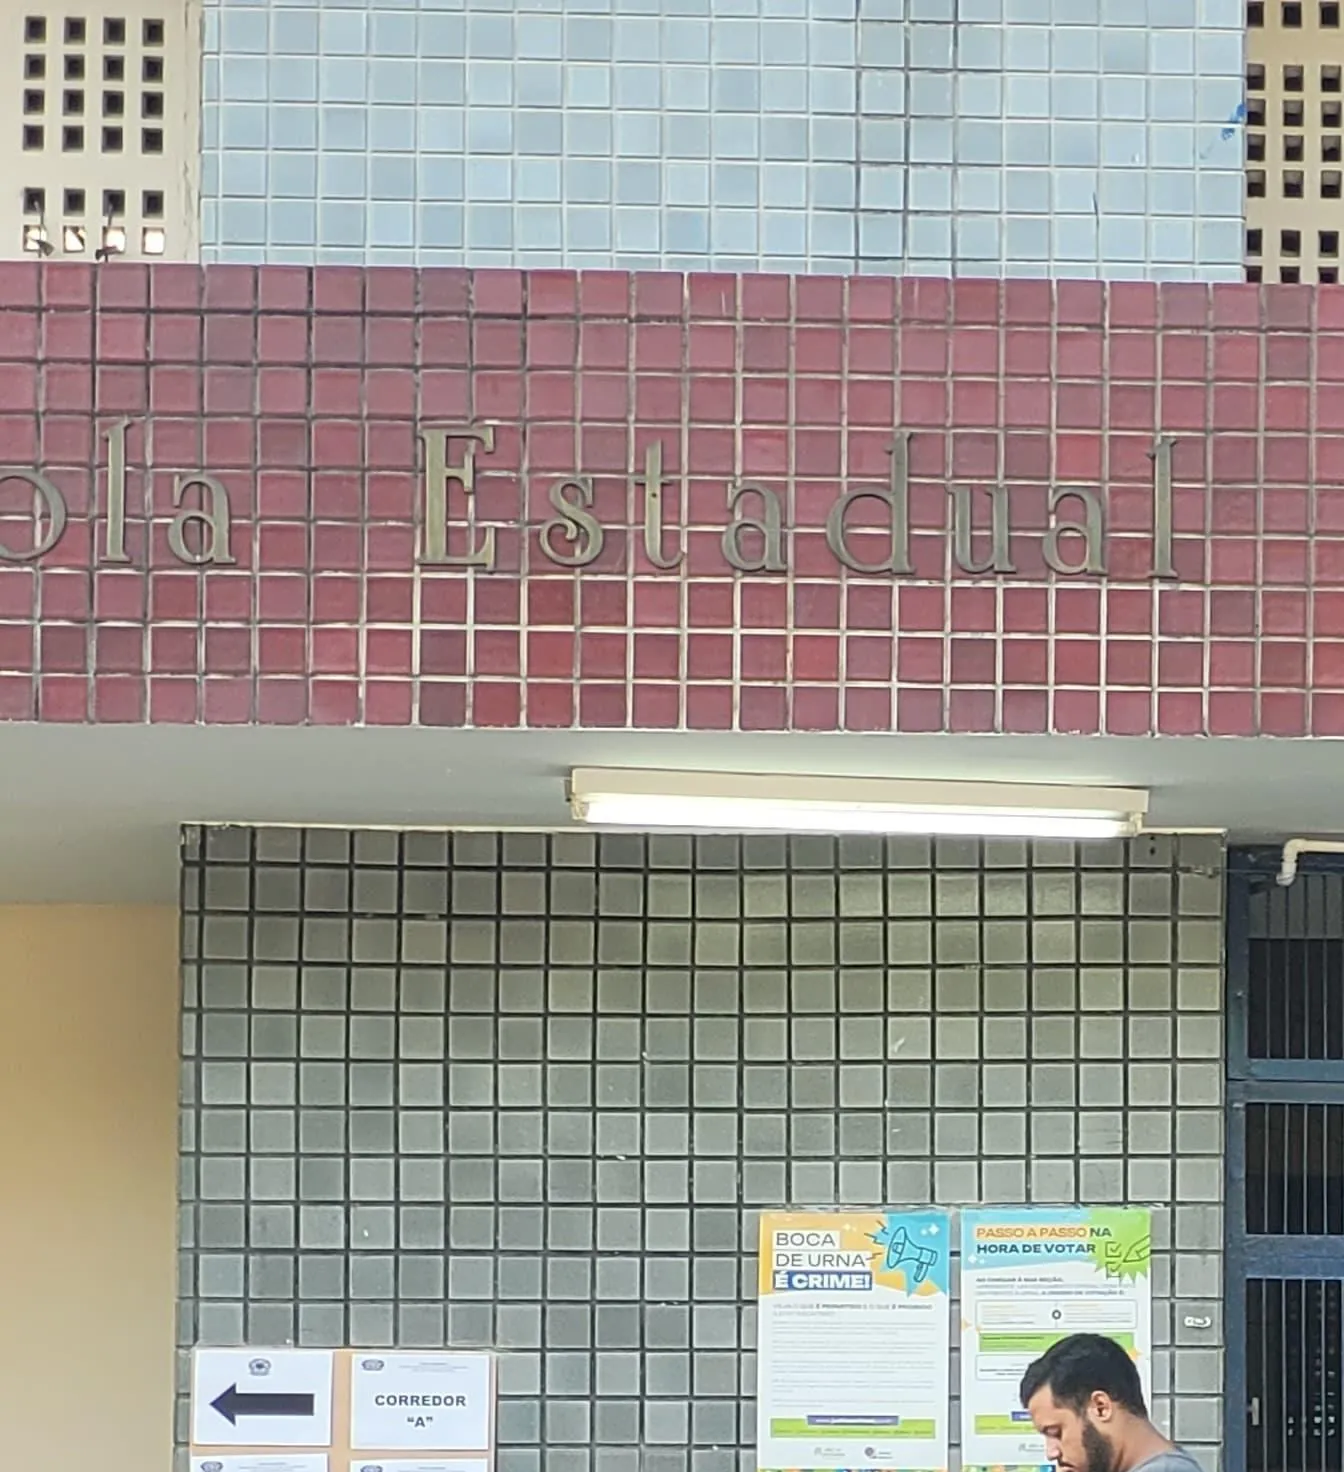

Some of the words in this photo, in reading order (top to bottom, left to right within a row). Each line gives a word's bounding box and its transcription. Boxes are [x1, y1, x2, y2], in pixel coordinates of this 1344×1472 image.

[418, 422, 1181, 580] Estadual
[776, 1231, 835, 1247] BOCA
[976, 1226, 1023, 1239] PASSO
[1026, 1226, 1037, 1239] A
[1040, 1226, 1087, 1239] PASSO
[1090, 1226, 1112, 1239] NA
[977, 1242, 1018, 1255] HORA
[1022, 1242, 1041, 1255] DE
[1043, 1242, 1096, 1254] VOTAR
[776, 1253, 804, 1267] DE
[807, 1253, 866, 1267] URNA
[775, 1271, 789, 1289] É
[792, 1274, 872, 1289] CRIME!
[374, 1394, 467, 1407] CORREDOR
